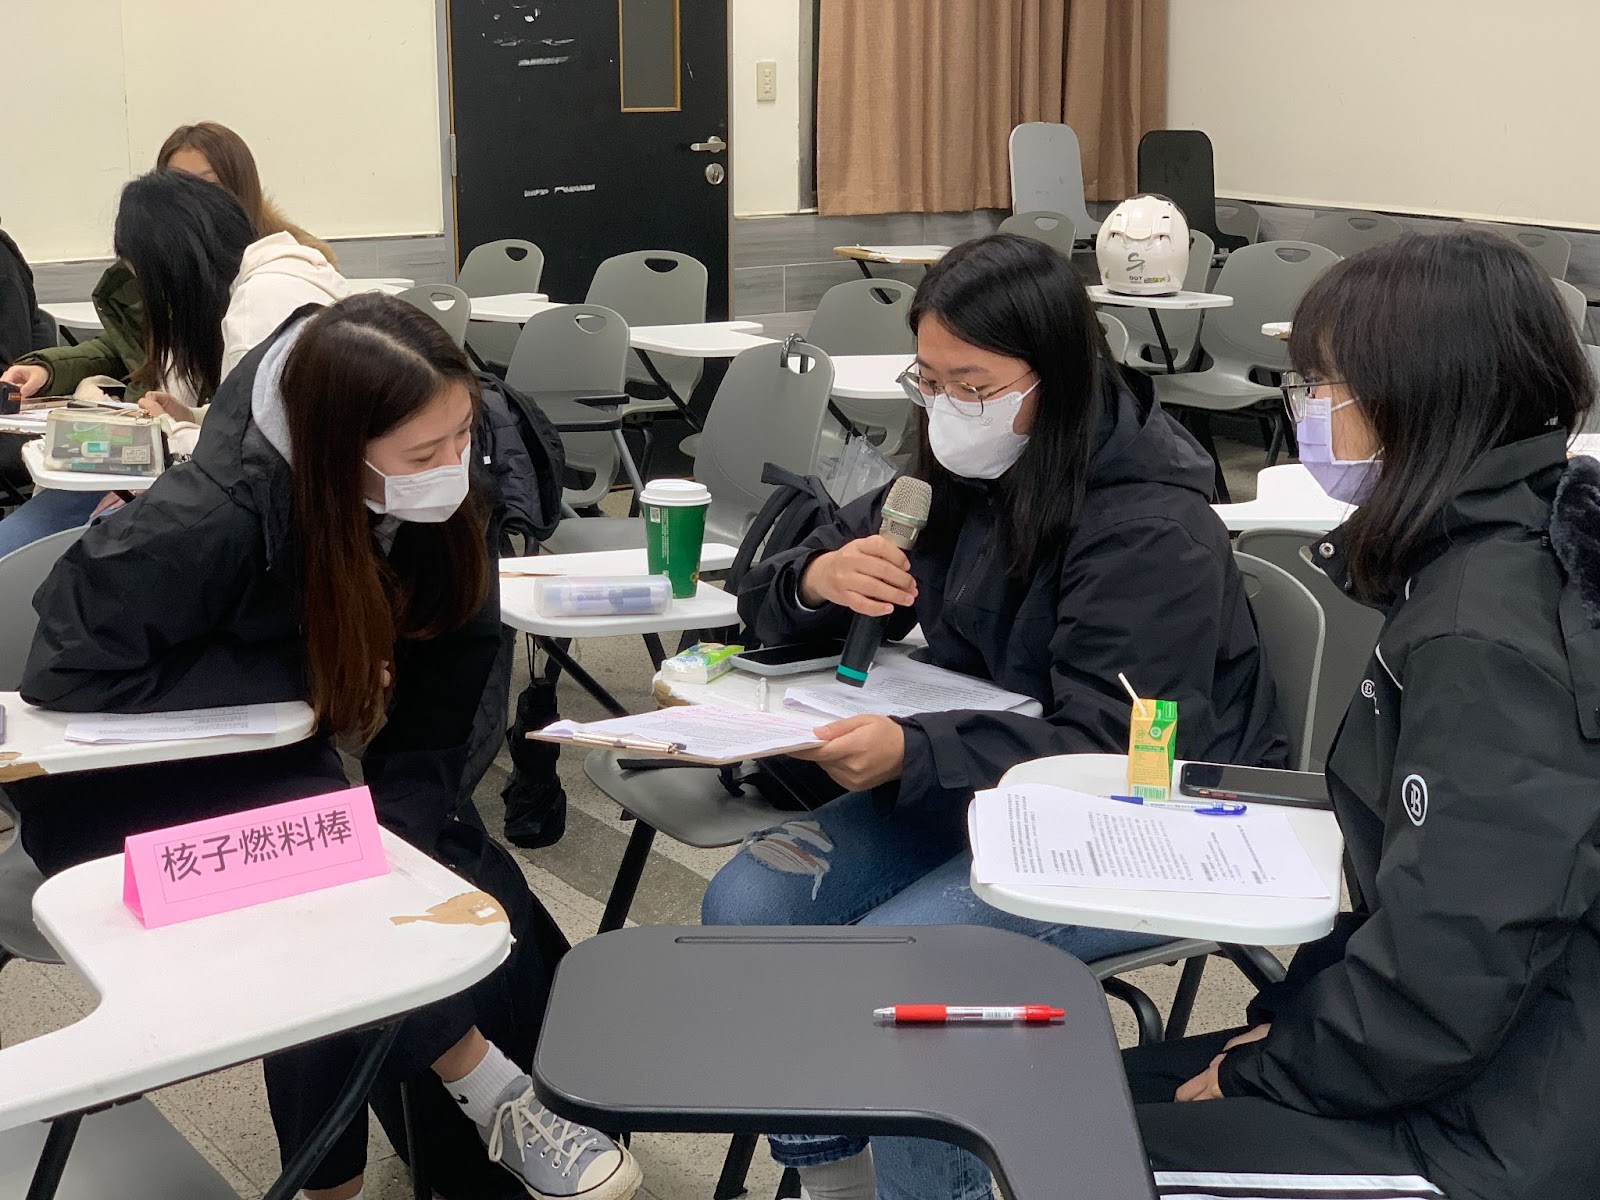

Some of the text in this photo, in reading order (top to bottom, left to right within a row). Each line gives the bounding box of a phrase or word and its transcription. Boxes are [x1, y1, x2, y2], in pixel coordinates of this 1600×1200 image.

[161, 810, 352, 882] 核子燃料棒
